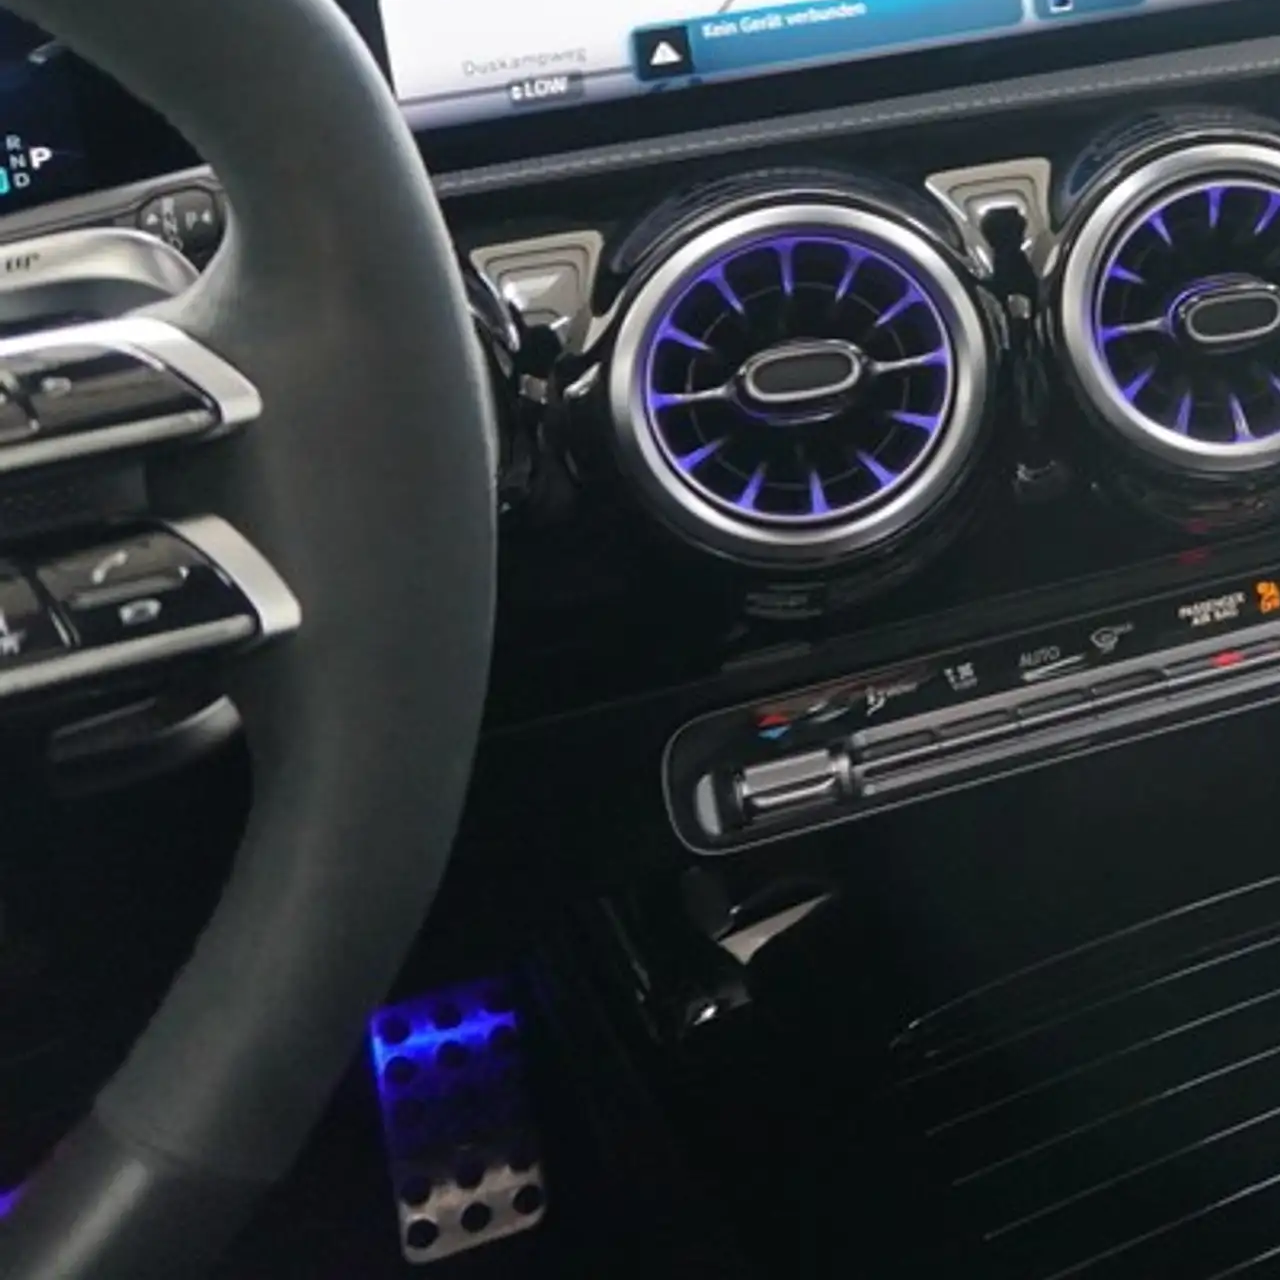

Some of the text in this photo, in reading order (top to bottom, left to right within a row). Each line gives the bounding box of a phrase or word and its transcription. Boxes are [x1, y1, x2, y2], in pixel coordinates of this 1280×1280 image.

[524, 76, 568, 98] LOW
[6, 134, 21, 151] R
[10, 153, 27, 169] N
[29, 147, 53, 169] P
[13, 172, 30, 188] D
[1019, 646, 1061, 667] AUTO
